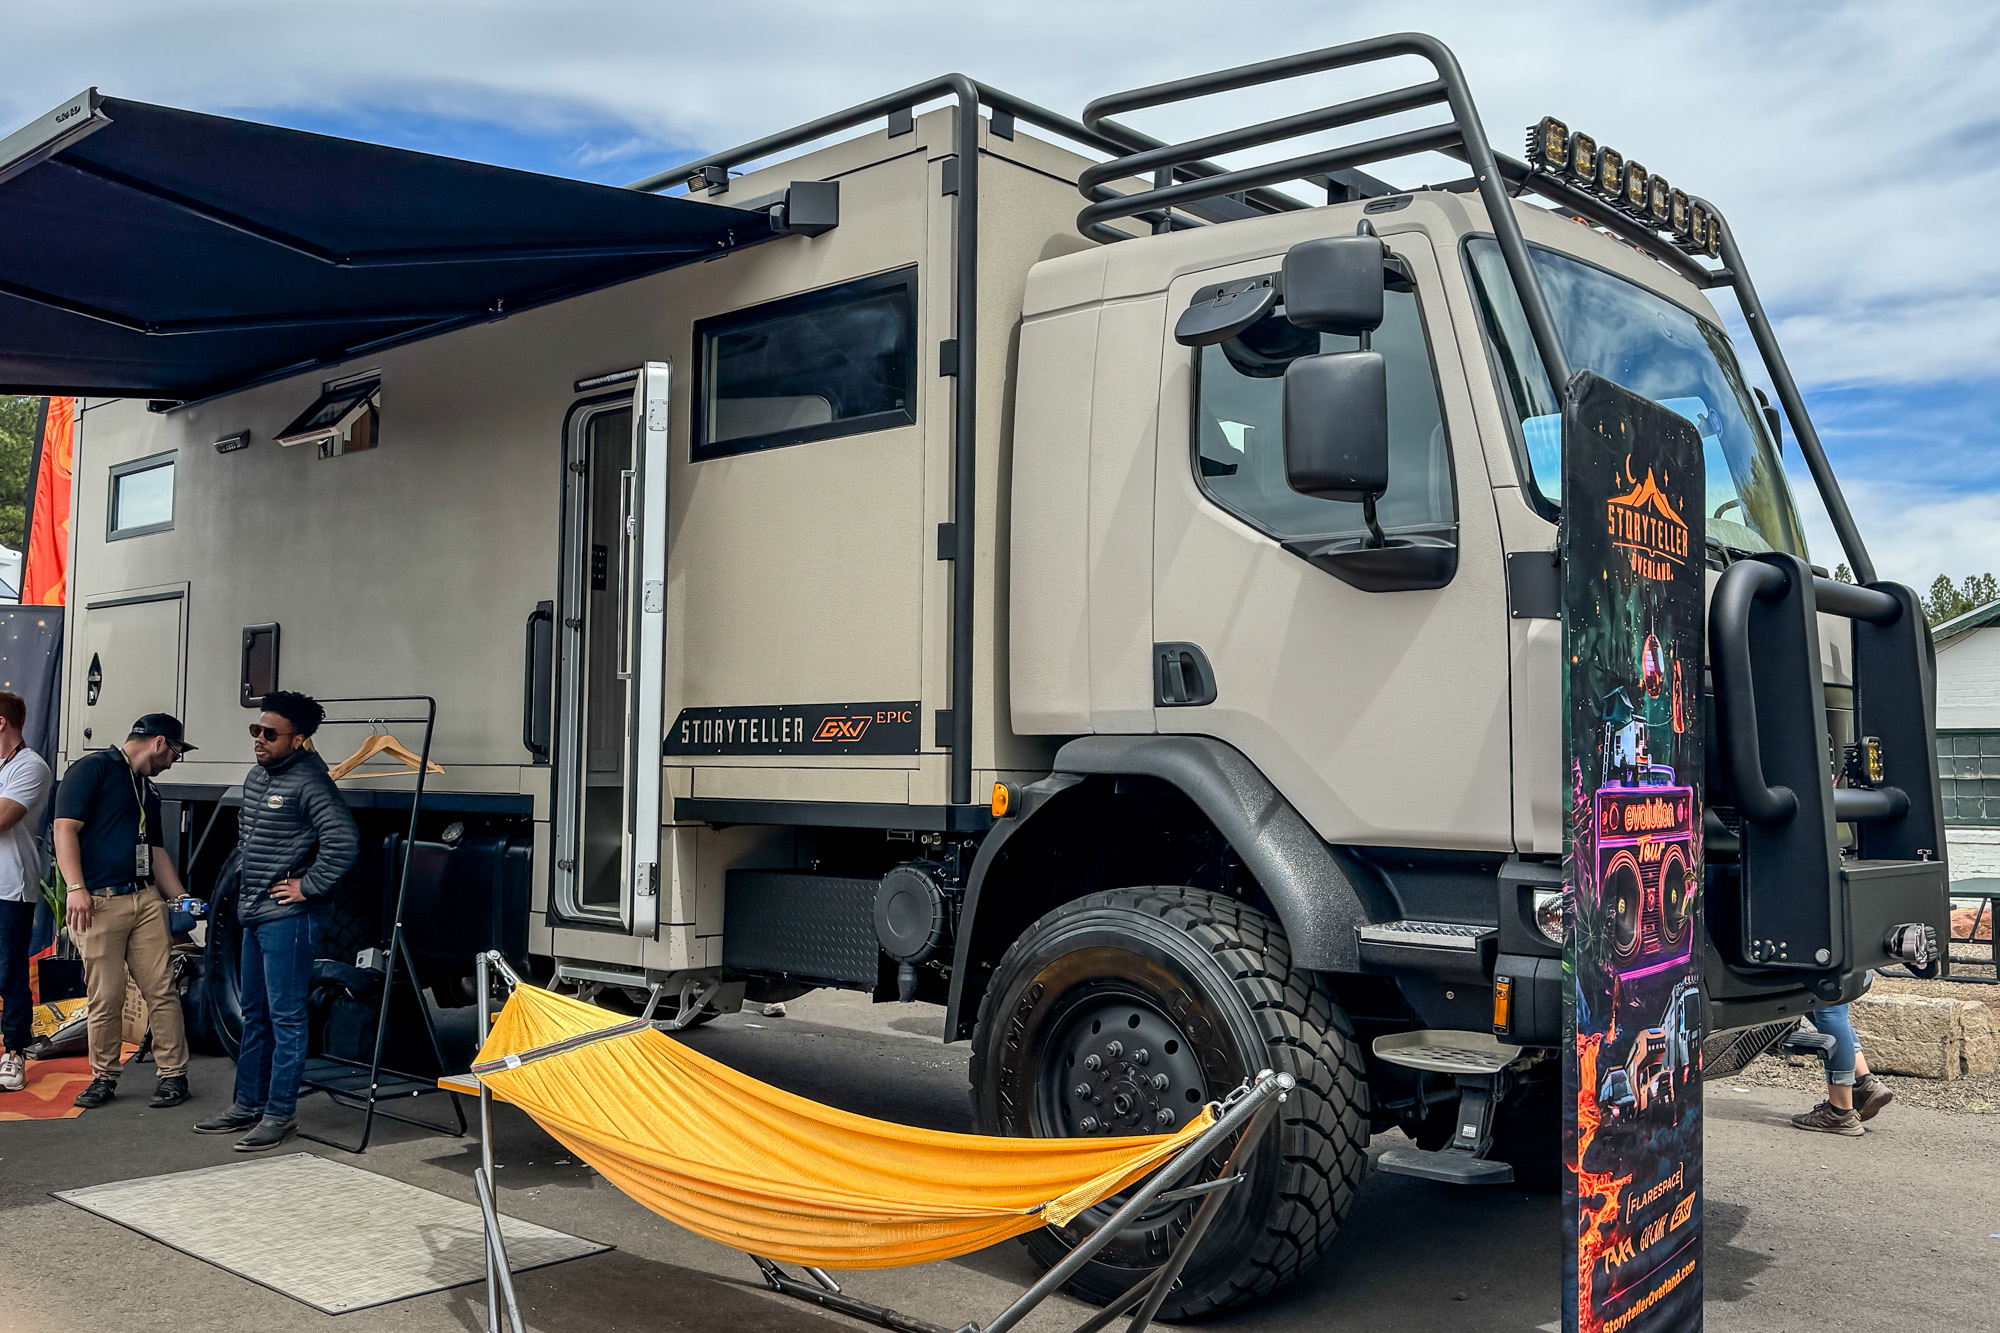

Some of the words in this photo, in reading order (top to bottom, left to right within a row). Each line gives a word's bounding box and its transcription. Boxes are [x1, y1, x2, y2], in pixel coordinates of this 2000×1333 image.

[1608, 504, 1688, 557] STORYTELLER
[681, 717, 804, 744] STORYTELLER
[817, 719, 868, 739] GXV
[876, 710, 913, 724] EPIC
[1624, 797, 1675, 832] evolution
[1637, 833, 1666, 863] Tour
[1602, 1259, 1696, 1333] StorytellerOverland.com
